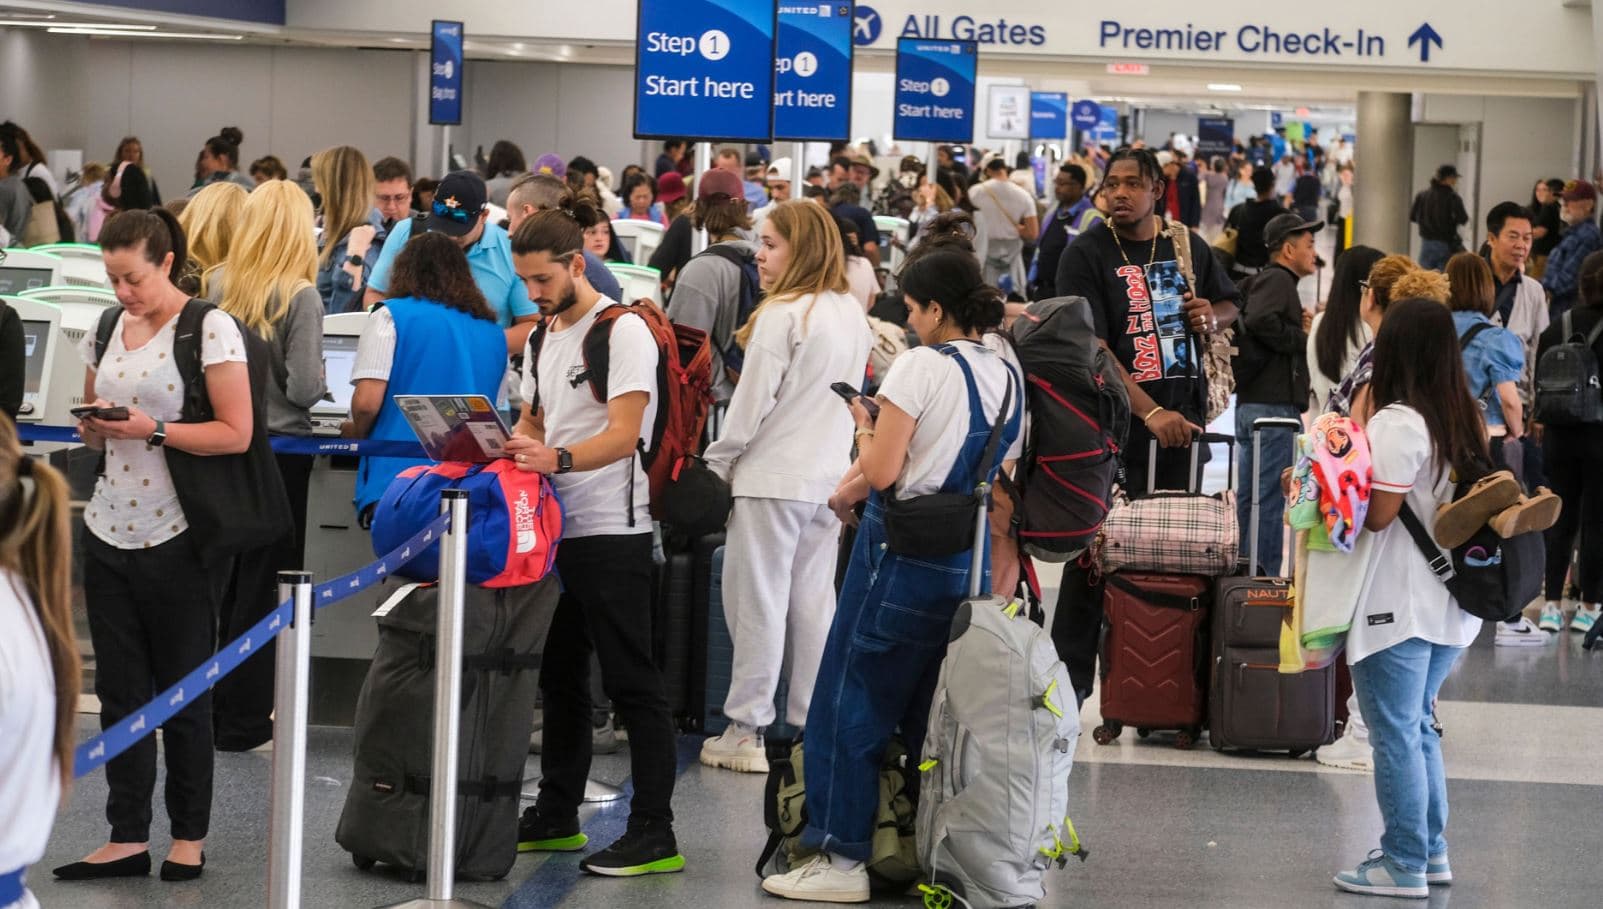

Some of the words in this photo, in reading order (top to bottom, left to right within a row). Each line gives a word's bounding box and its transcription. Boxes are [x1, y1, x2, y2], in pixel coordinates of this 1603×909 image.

[901, 15, 939, 40] All
[951, 16, 1046, 46] Gates
[1100, 21, 1227, 51] Premier
[1236, 25, 1385, 56] Check-In
[646, 32, 696, 56] Step
[775, 57, 792, 74] ep
[645, 76, 699, 97] Start
[704, 77, 754, 99] here
[900, 79, 930, 94] Step
[774, 90, 794, 107] art
[797, 89, 836, 108] here
[899, 104, 931, 118] Start
[933, 105, 964, 119] here
[1116, 265, 1151, 312] HOOD
[1126, 315, 1141, 334] N
[1131, 334, 1162, 382] BOYZ
[514, 501, 524, 530] FACE
[520, 490, 529, 530] NORTH
[527, 506, 536, 529] THE
[1247, 589, 1288, 599] NAUT
